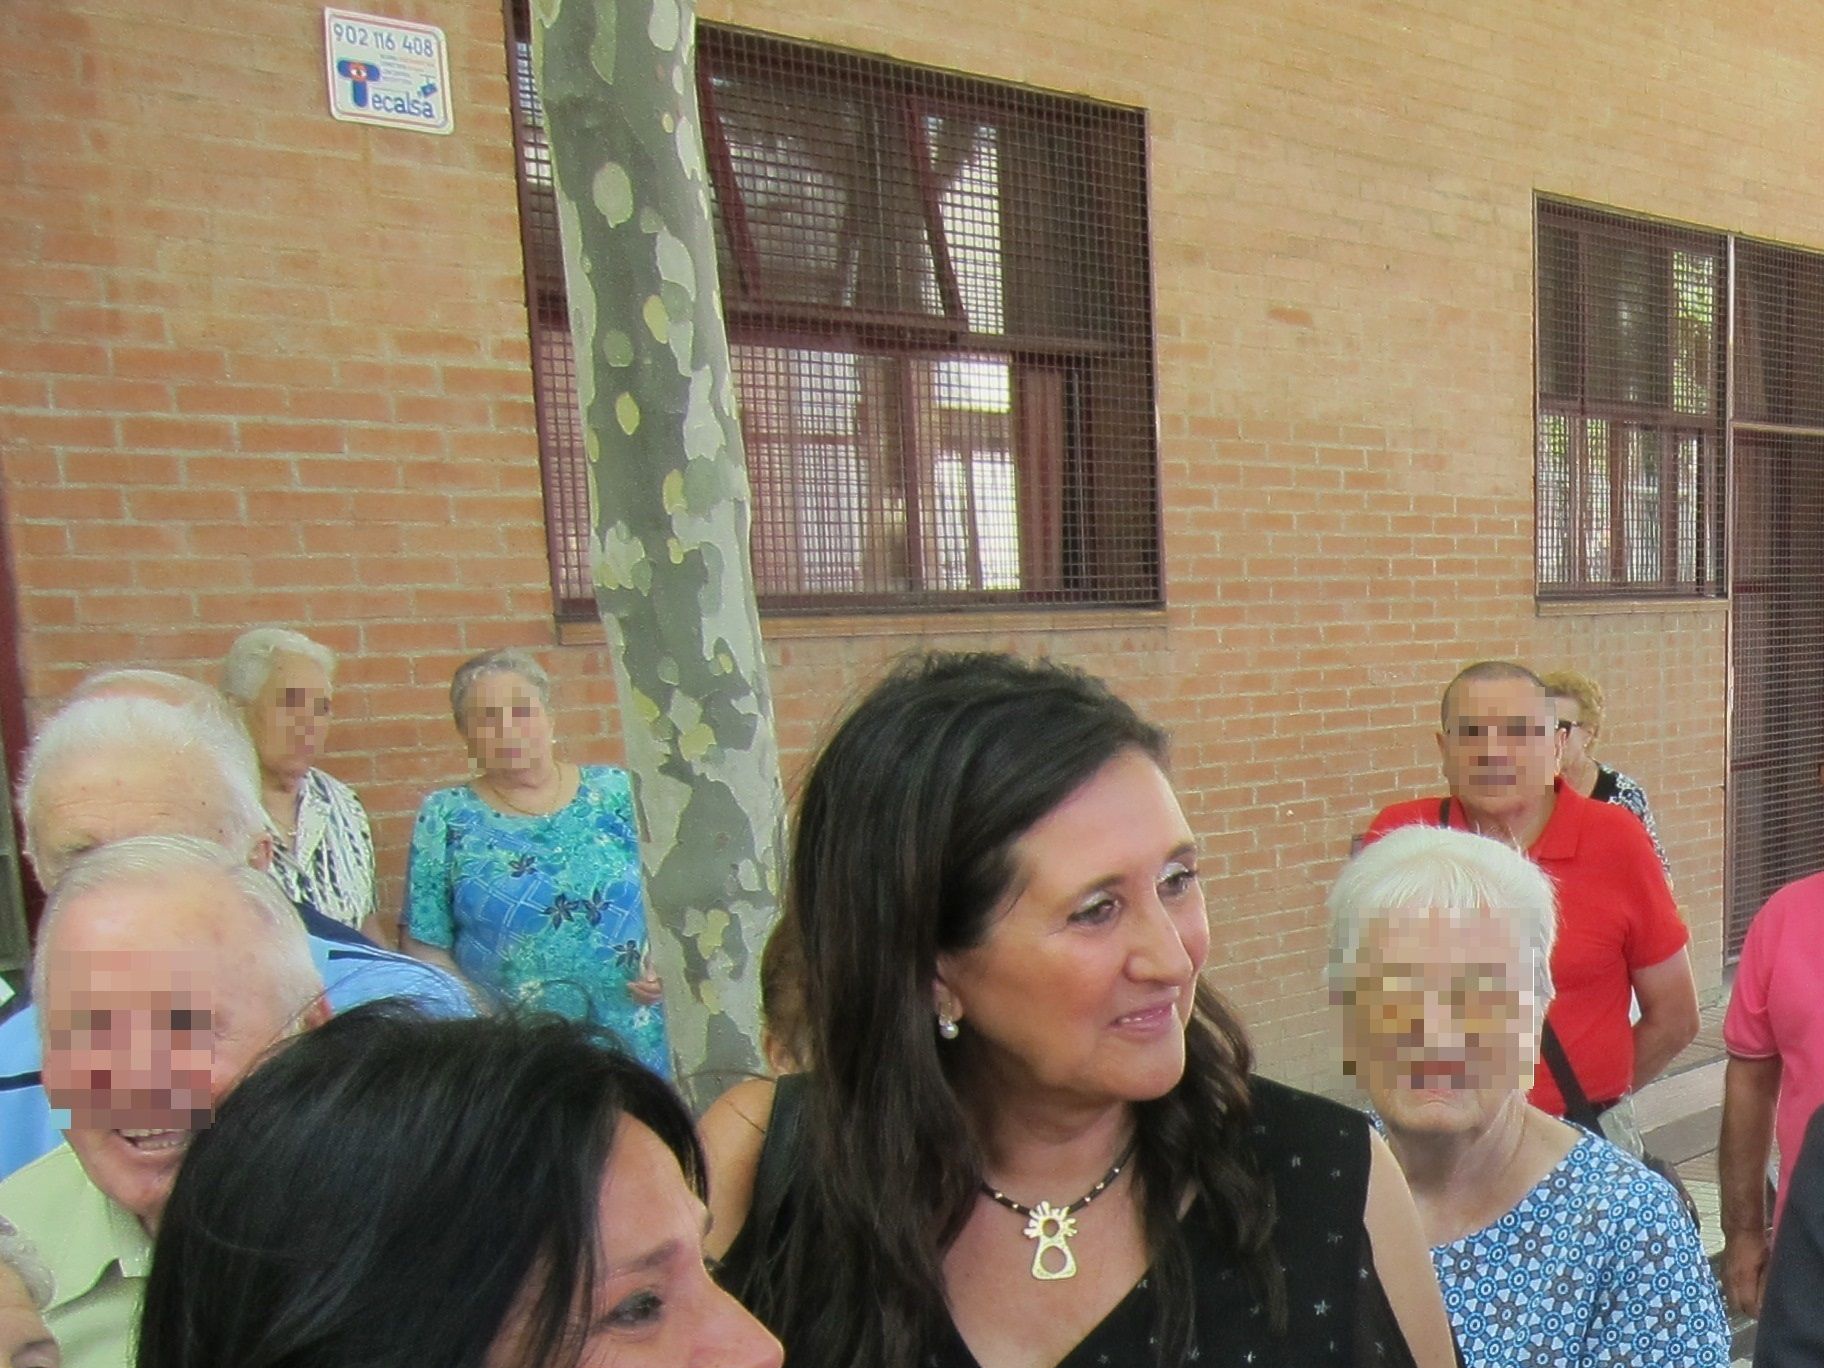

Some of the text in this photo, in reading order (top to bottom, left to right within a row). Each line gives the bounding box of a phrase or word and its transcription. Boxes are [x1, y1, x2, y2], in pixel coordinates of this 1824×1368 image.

[333, 23, 434, 58] 902 116 408
